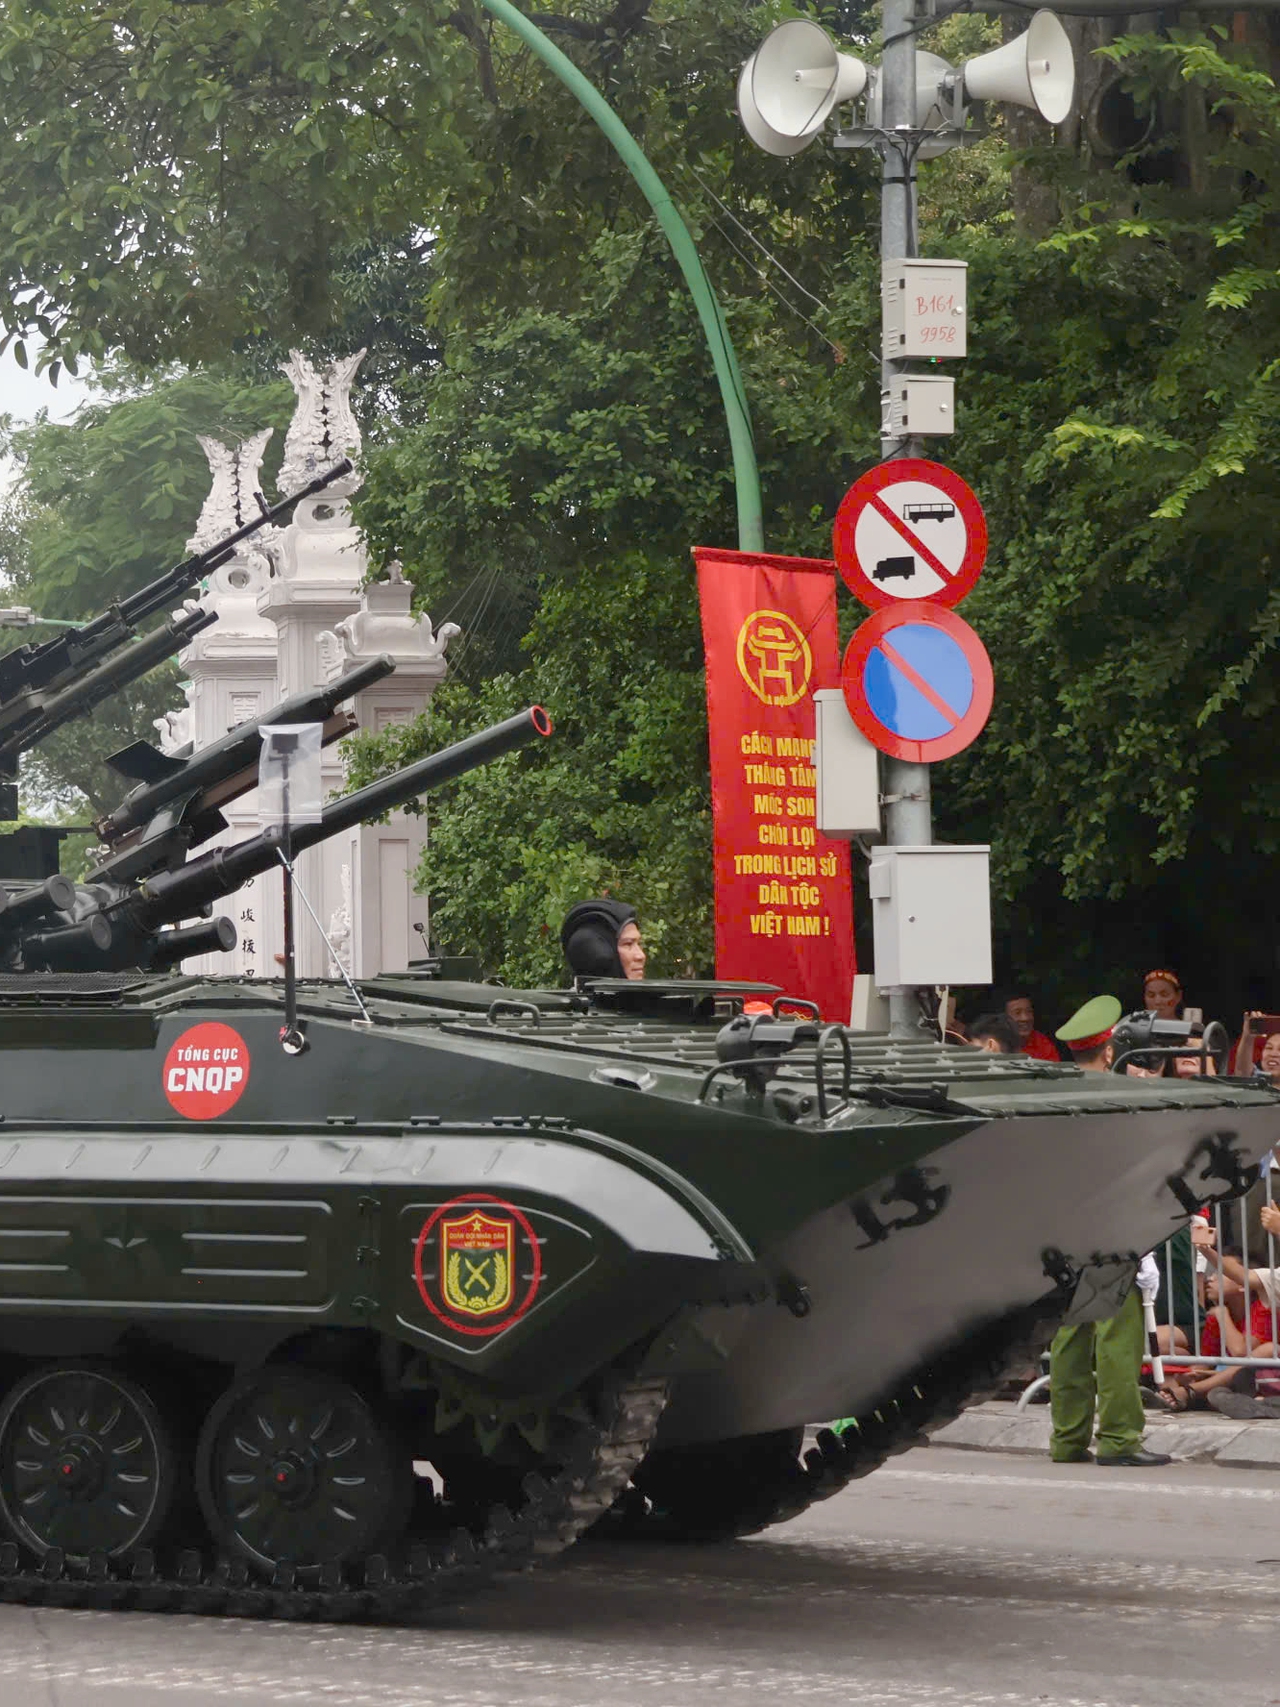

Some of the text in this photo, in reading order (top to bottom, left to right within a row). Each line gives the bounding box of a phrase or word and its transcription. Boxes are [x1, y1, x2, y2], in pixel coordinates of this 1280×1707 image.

[916, 294, 954, 316] B161
[920, 326, 957, 344] 9958
[744, 761, 786, 787] THÁNG
[792, 827, 815, 850] LỌI
[734, 851, 837, 880] TRONG LỊCH SỬ
[759, 880, 819, 910] DÂN TỘC
[750, 910, 783, 938] VIỆT
[787, 916, 820, 936] NAM
[177, 1044, 239, 1063] TỔNG CỤC
[167, 1067, 243, 1094] CNQP
